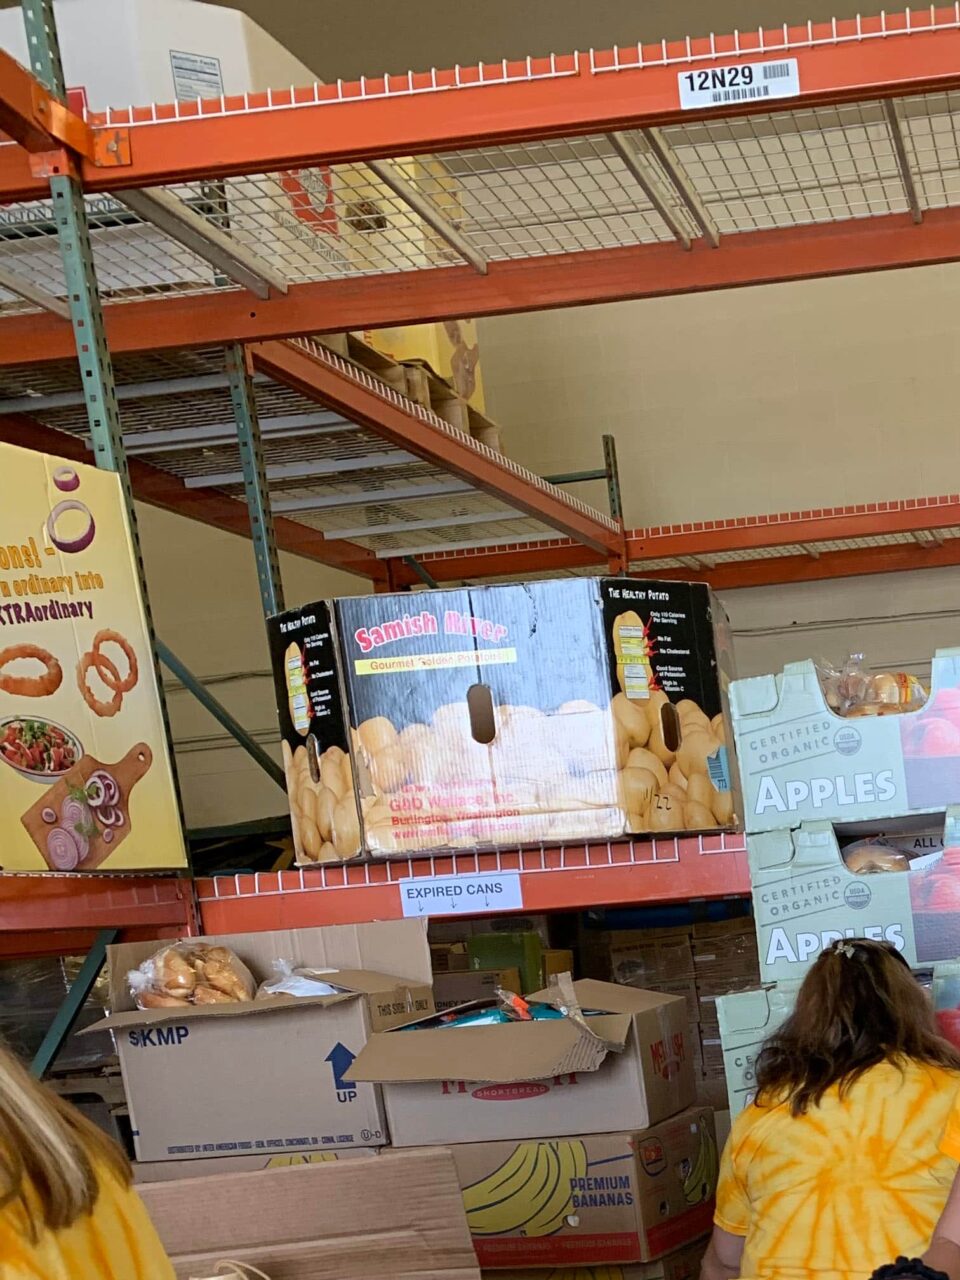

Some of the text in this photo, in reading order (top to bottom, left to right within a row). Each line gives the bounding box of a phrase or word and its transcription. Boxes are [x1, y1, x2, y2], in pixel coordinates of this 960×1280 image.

[684, 65, 754, 92] 12N29
[13, 573, 73, 597] ordinary
[75, 570, 104, 591] into
[609, 588, 670, 601] THE HEALTHY POTATO
[355, 611, 438, 652] Samish
[370, 659, 415, 671] Gourmet
[750, 721, 831, 750] CERTIFIED
[759, 736, 830, 763] ORGANIC
[754, 770, 897, 815] APPLES
[914, 838, 937, 849] ALL
[406, 883, 503, 899] EXPIRED CANS
[761, 875, 841, 903] CERTIFIED
[770, 890, 841, 916] ORGANIC
[337, 1091, 357, 1103] UP
[476, 1085, 547, 1097] SHORTBREAD
[569, 1176, 630, 1192] PREMIUM
[572, 1192, 633, 1209] BANANAS
